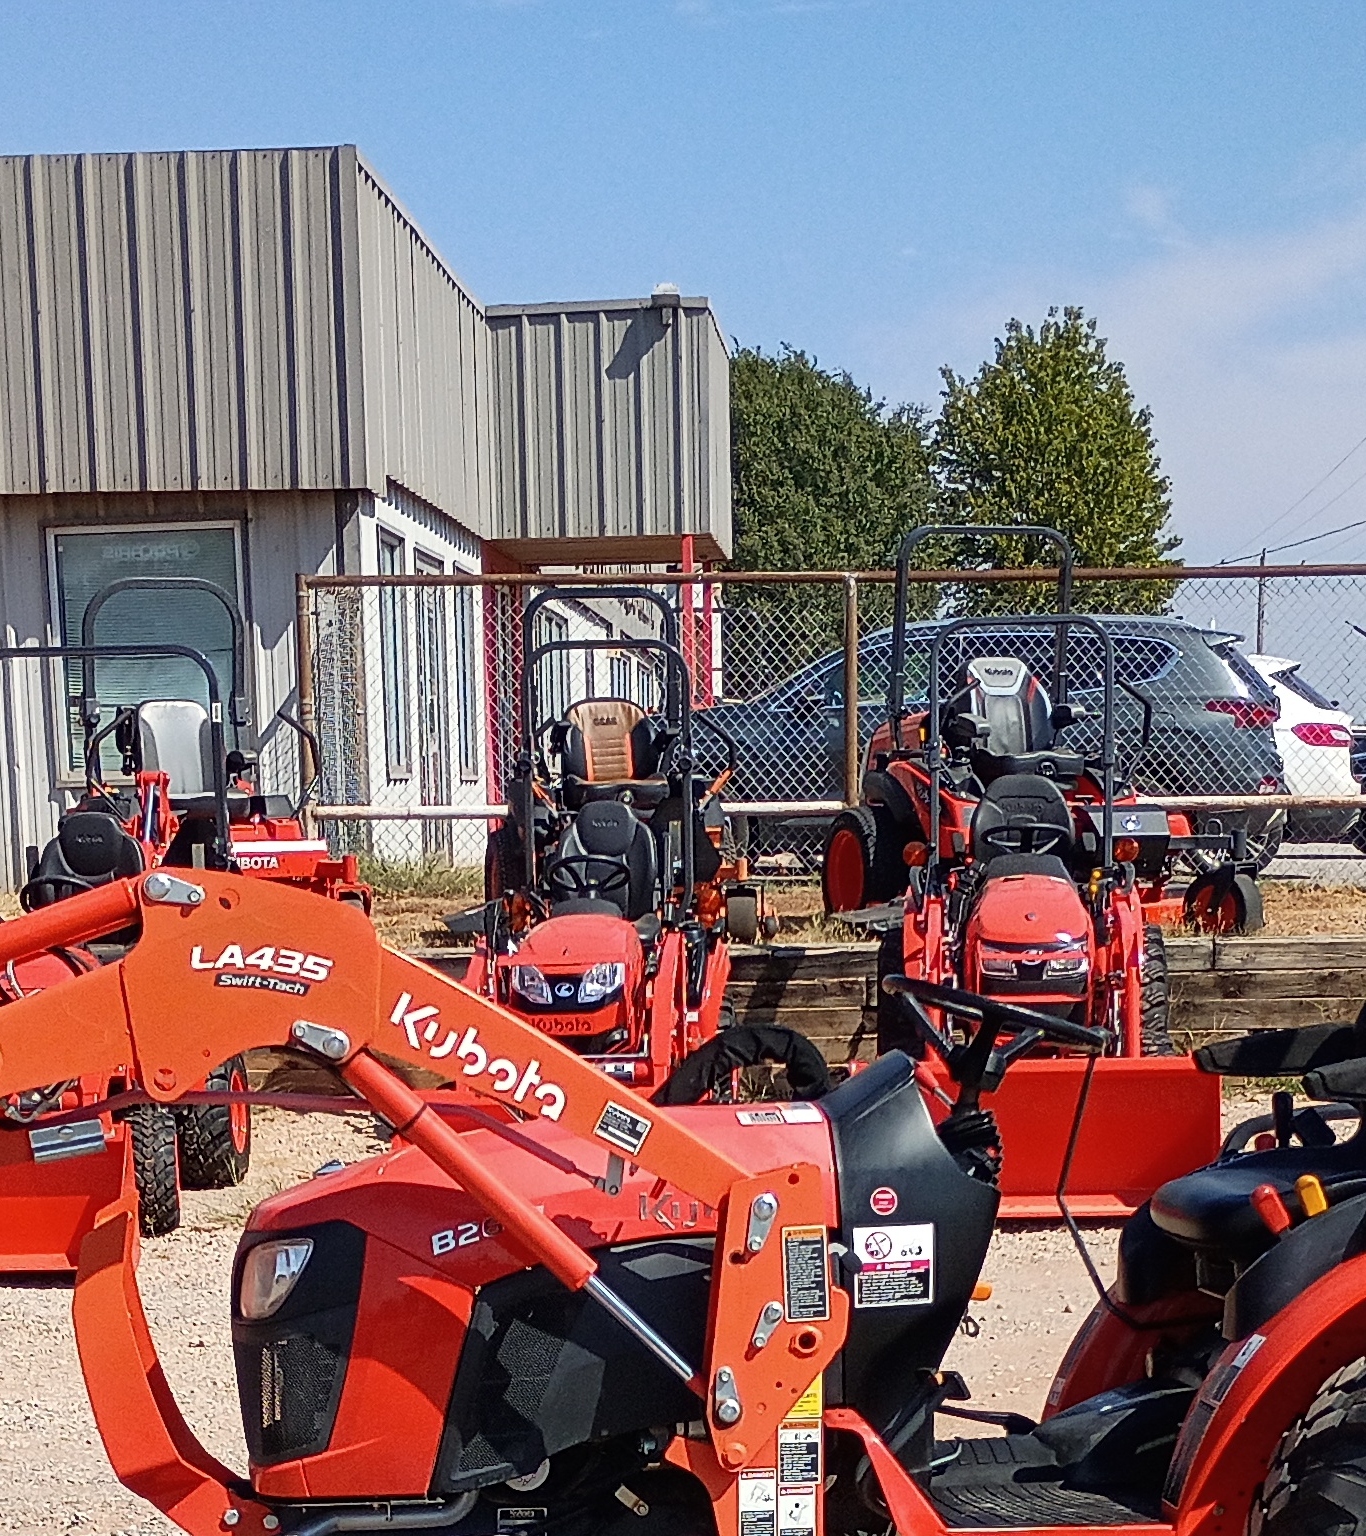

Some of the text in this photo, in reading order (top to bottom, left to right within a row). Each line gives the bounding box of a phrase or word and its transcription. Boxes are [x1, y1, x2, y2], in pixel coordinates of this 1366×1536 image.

[984, 667, 1014, 677] Kubota
[236, 856, 279, 869] BOTA
[190, 943, 335, 984] LA435
[218, 974, 306, 995] Swift-Tach
[531, 1017, 592, 1033] Kubota
[389, 991, 567, 1122] Kubota
